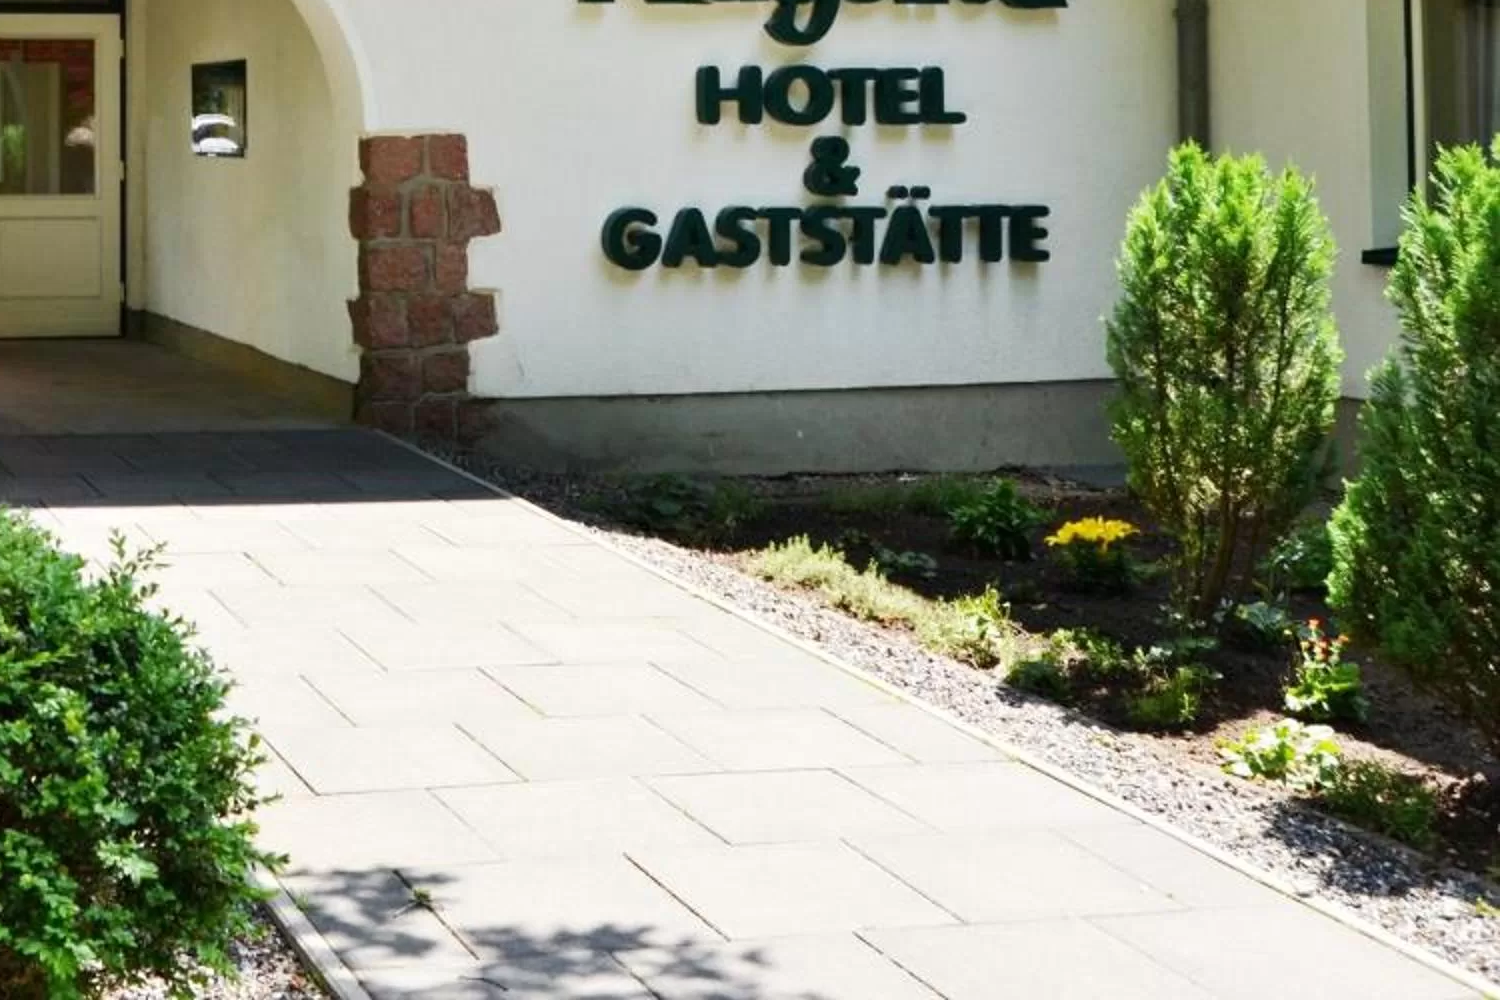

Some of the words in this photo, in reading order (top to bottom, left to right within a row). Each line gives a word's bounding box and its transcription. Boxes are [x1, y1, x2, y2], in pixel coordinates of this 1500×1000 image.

[695, 65, 967, 126] HOTEL
[803, 135, 861, 198] &
[601, 185, 1050, 270] GASTSTÄTTE
